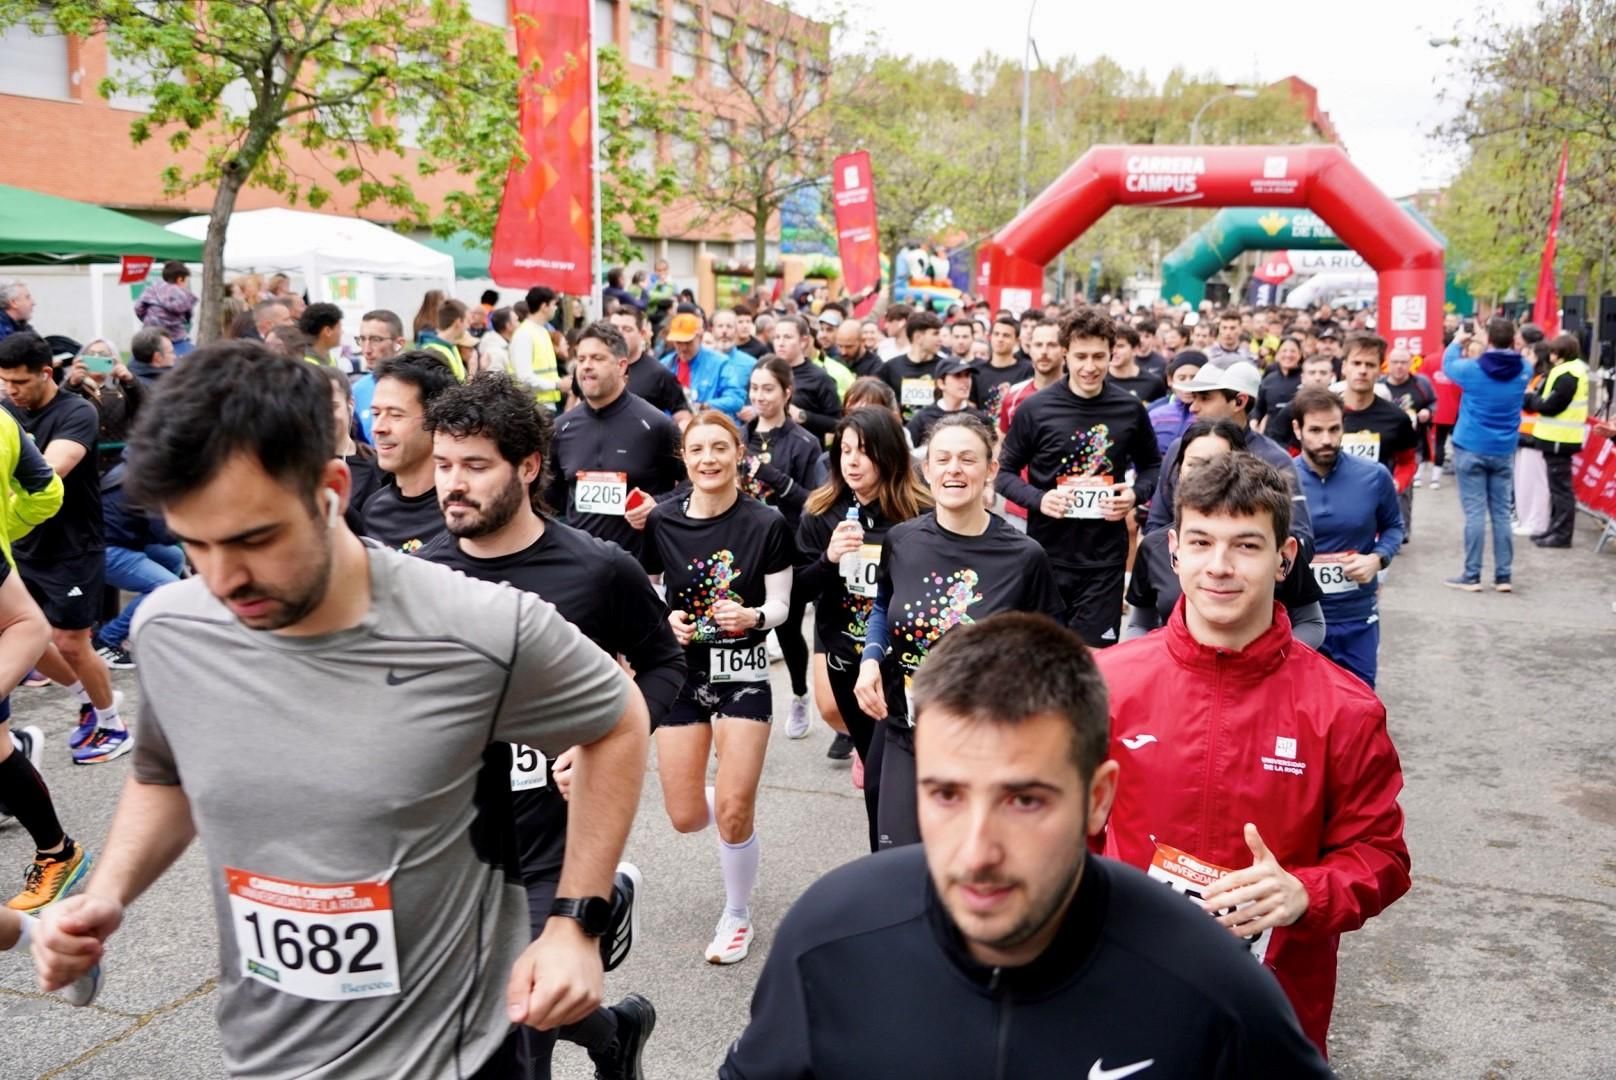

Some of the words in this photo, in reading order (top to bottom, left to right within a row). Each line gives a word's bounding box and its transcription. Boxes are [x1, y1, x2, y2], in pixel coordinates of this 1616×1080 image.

[1127, 156, 1205, 175] CARRERA
[1125, 175, 1197, 193] CAMPUS
[1302, 256, 1325, 268] LA
[580, 485, 621, 504] 2205
[715, 647, 767, 672] 1648
[1261, 756, 1306, 769] UNIVERSIDAD
[1263, 763, 1274, 771] DE
[1275, 765, 1284, 773] LA
[1284, 767, 1303, 775] RIOJA
[1178, 855, 1218, 878] CARRERA
[245, 912, 384, 975] 1682
